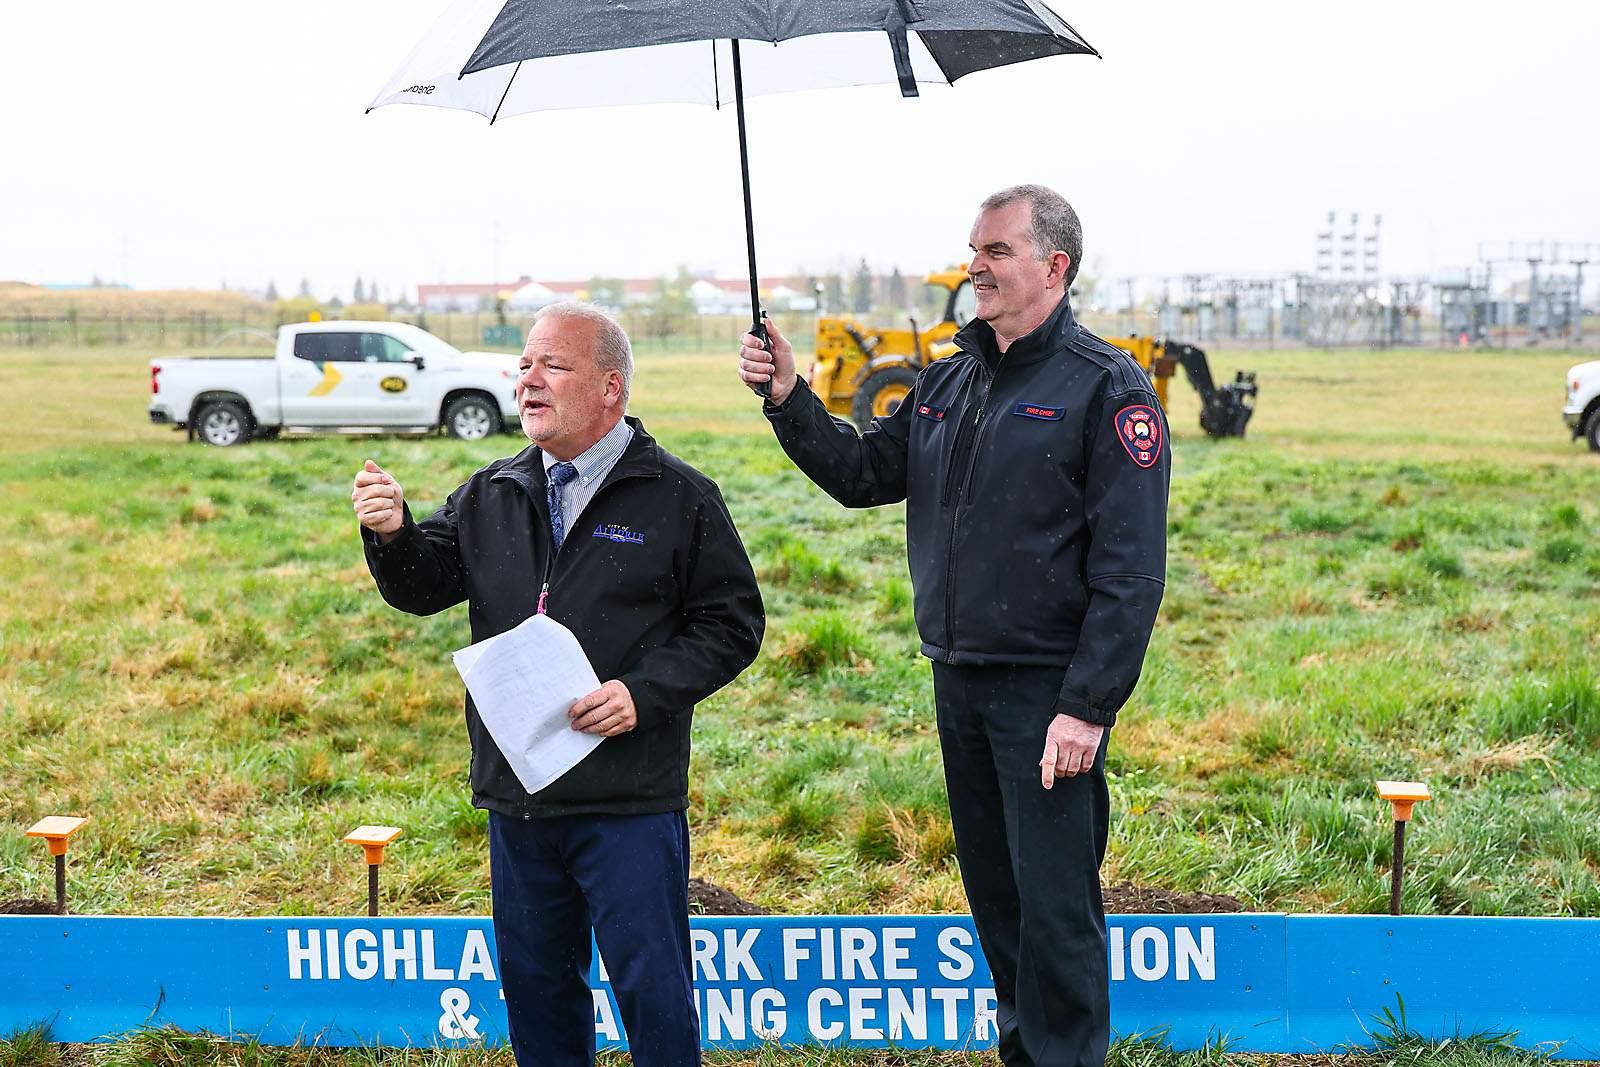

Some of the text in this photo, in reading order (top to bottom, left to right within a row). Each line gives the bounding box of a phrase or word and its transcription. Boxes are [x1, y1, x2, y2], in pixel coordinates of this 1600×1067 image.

[593, 523, 645, 541] AIRDRIE
[287, 928, 498, 981] HIGHLA
[783, 927, 918, 981] FIRE
[937, 926, 1216, 982] SION
[439, 987, 484, 1040] &
[807, 987, 1000, 1041] CENTR
